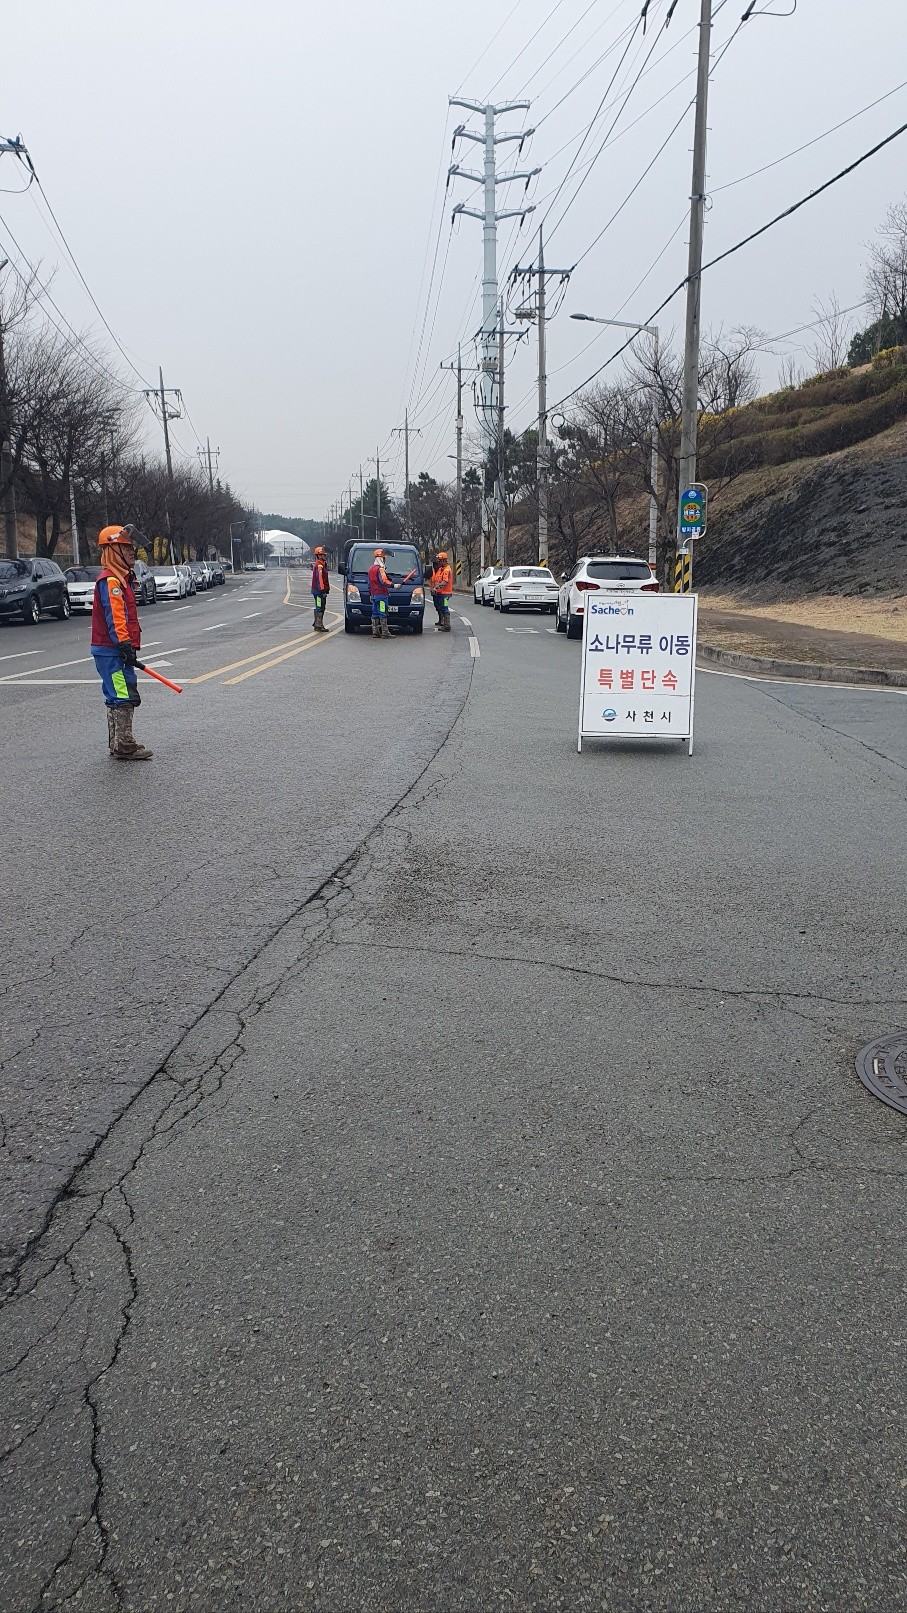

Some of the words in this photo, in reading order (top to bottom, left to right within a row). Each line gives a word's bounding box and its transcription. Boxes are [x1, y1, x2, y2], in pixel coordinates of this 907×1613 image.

[588, 634, 653, 655] 소나무류
[659, 634, 691, 656] 이동
[597, 668, 678, 691] 특별단속
